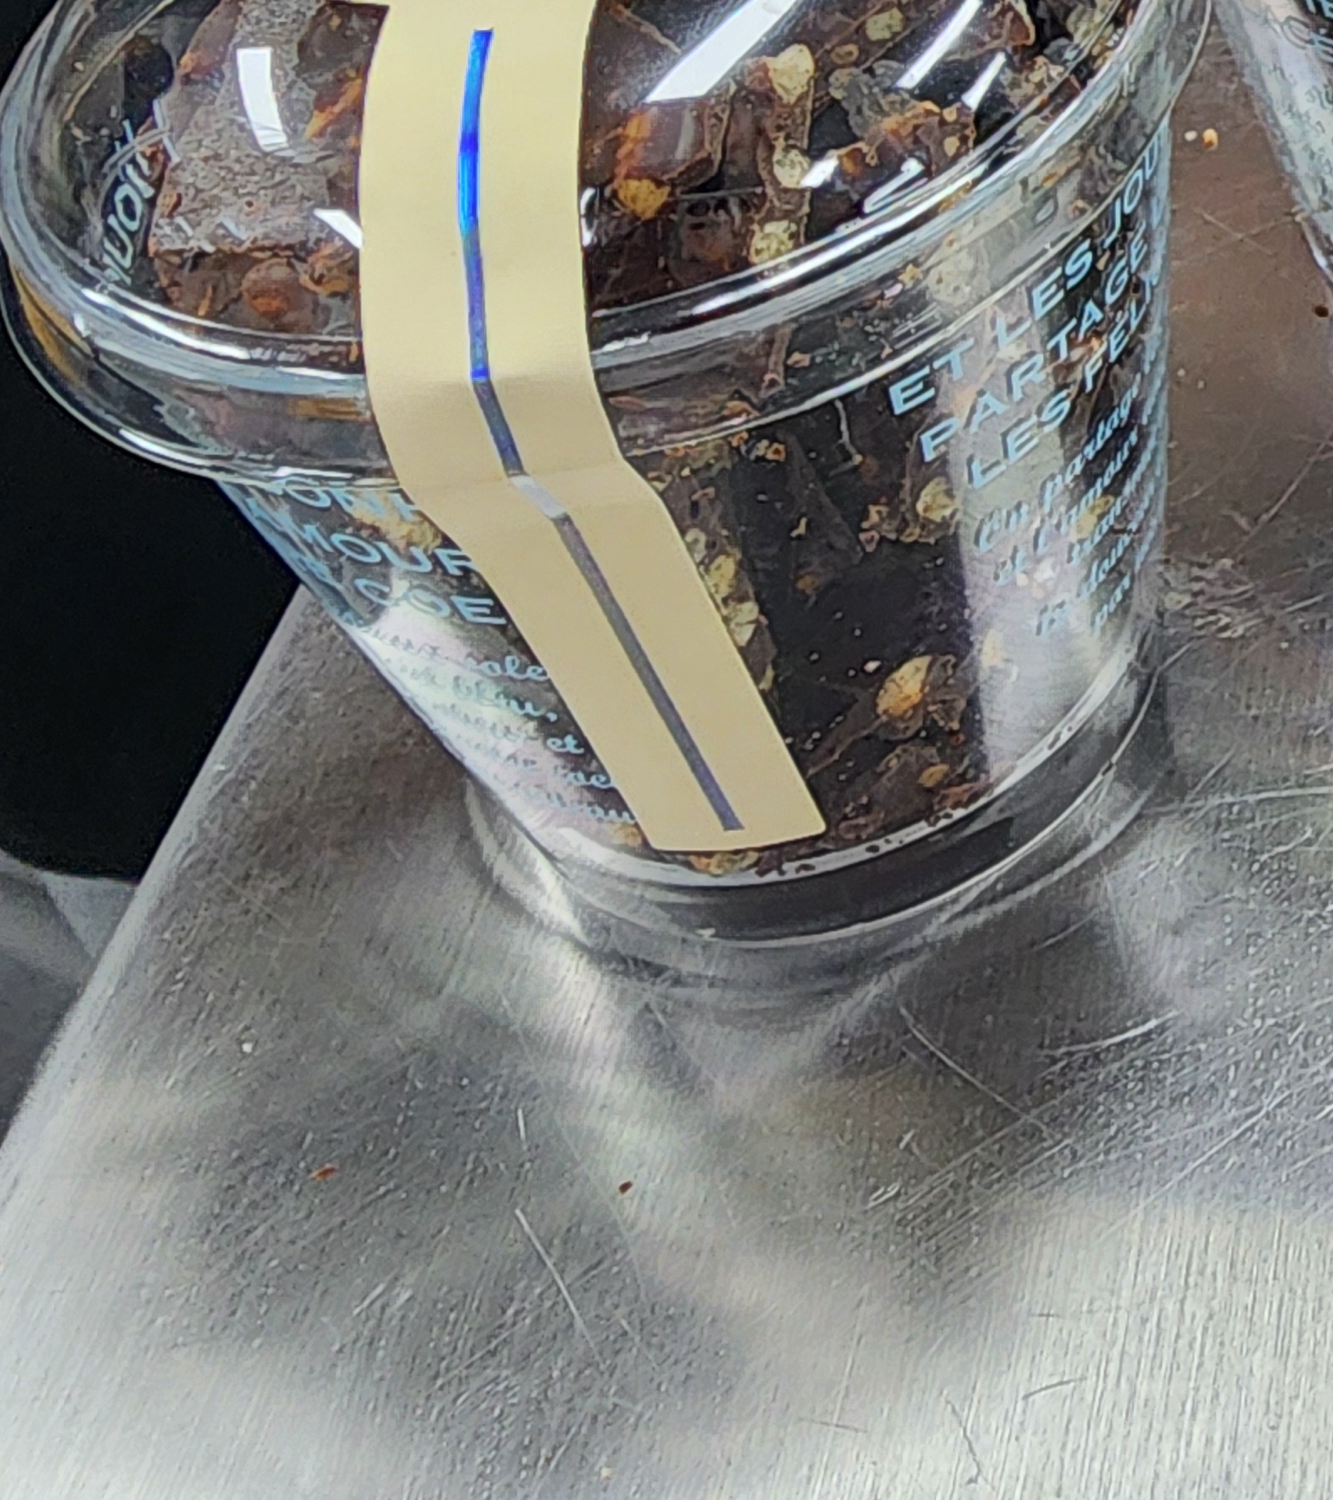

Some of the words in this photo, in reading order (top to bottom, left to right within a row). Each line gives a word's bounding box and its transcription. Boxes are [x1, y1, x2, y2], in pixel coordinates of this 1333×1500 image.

[887, 337, 975, 416] ET
[995, 238, 1093, 348] LES
[968, 388, 1072, 490] LES
